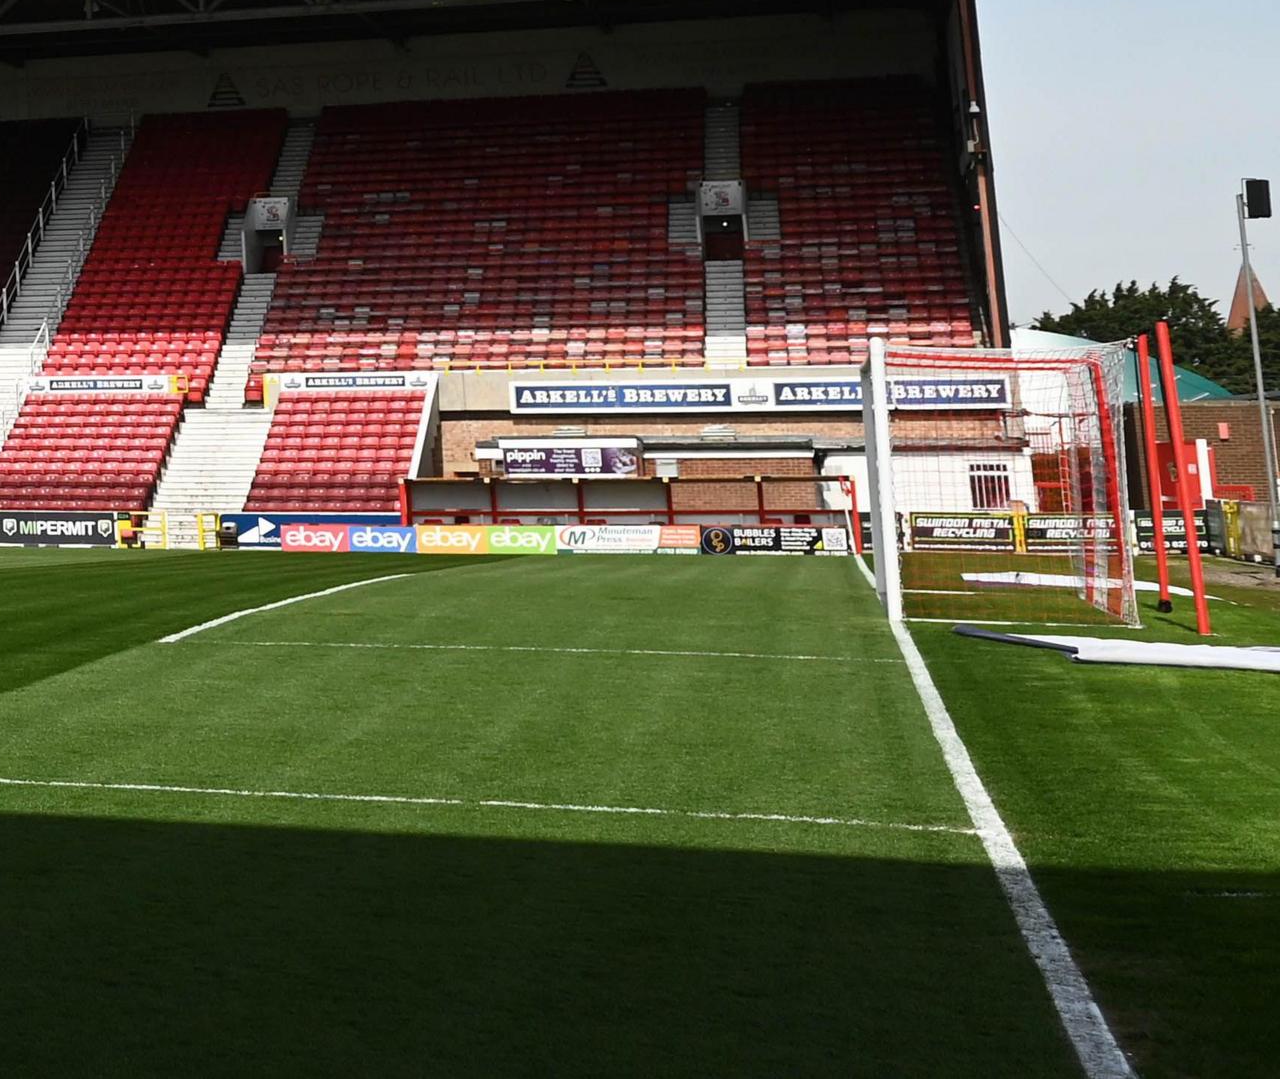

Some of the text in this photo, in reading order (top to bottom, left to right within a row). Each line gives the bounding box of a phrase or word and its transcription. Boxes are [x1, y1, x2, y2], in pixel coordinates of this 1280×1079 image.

[318, 72, 384, 94] ROPE
[426, 66, 482, 88] RAIL
[497, 63, 548, 84] LTD
[356, 378, 403, 386] BREWERY
[520, 387, 727, 404] ARKELL'S BREWERY
[894, 384, 1001, 399] BREWERY
[506, 449, 546, 463] pippin
[20, 520, 95, 536] MIPERMIT
[917, 518, 1011, 528] SWINDON METAL
[1029, 519, 1082, 528] SWINDON
[597, 527, 653, 535] Minuteman
[733, 529, 776, 538] BUBBLES
[933, 528, 996, 537] RECYCLING
[1046, 528, 1110, 538] RECYCLING
[286, 526, 344, 551] ebay
[352, 527, 412, 552] ebay
[422, 526, 482, 551] ebay
[490, 527, 552, 552] ebay
[596, 535, 623, 543] Press
